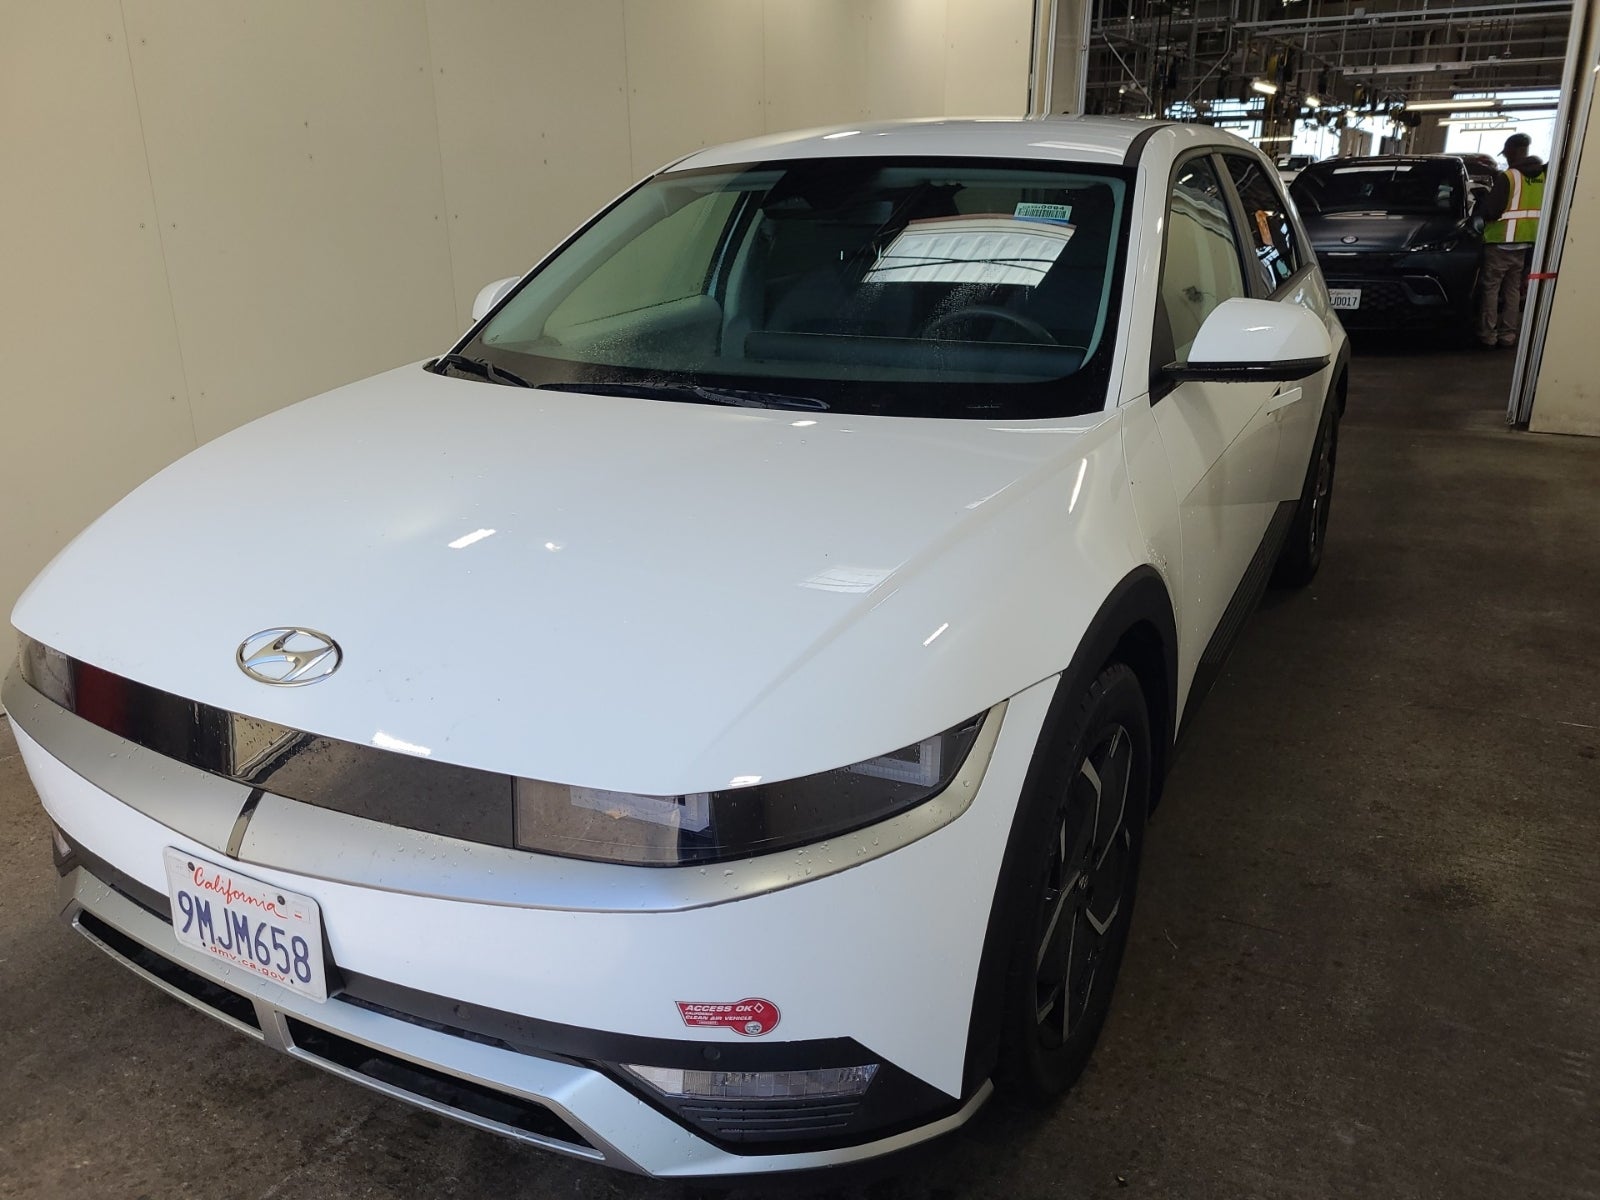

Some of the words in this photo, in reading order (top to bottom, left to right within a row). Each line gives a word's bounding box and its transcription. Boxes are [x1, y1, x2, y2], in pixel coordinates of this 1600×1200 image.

[194, 866, 288, 920] California
[178, 890, 312, 984] 9MJM658
[210, 946, 286, 982] dmv.ca.gov
